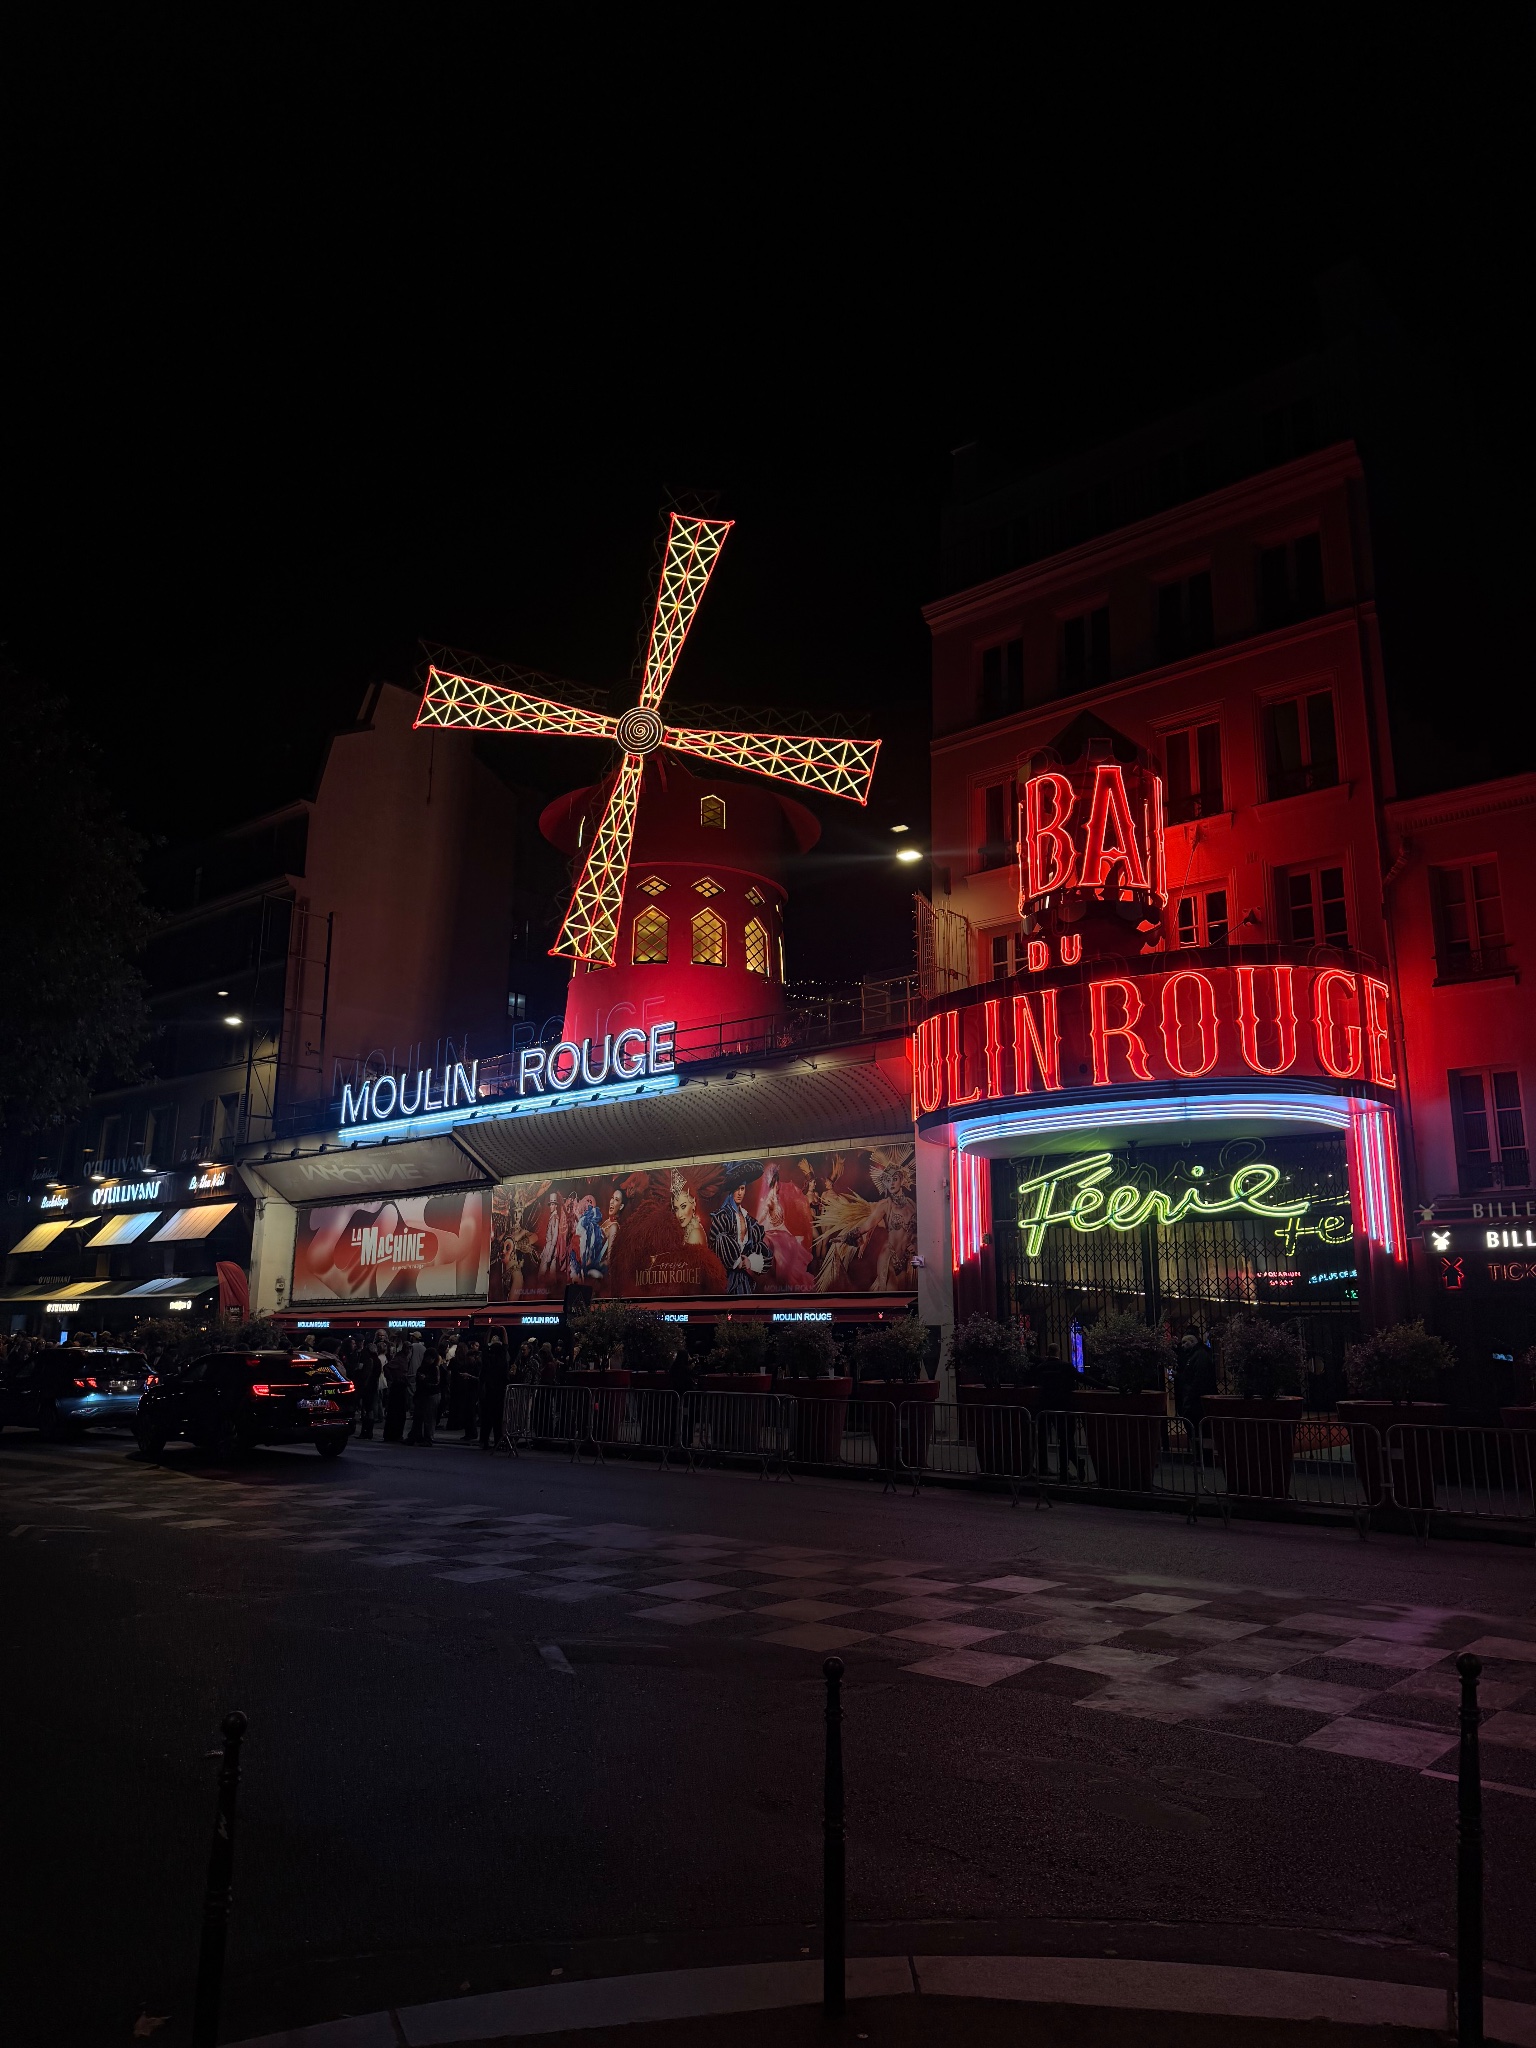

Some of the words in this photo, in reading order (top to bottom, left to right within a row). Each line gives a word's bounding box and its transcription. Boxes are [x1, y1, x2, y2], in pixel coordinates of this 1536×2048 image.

[1027, 934, 1083, 972] DU
[913, 989, 1064, 1121] ULIN
[1089, 965, 1396, 1090] ROUGE
[340, 1058, 479, 1124] MOULIN
[519, 1021, 677, 1096] ROUGE
[1018, 1153, 1311, 1258] Féerie
[351, 1228, 361, 1242] LA
[1486, 1229, 1536, 1248] BILL
[635, 1269, 668, 1287] MOULIN
[669, 1267, 701, 1285] ROUGE
[1487, 1263, 1536, 1281] TICK
[408, 1320, 426, 1328] ROUGE
[522, 1316, 543, 1324] MOULIN
[664, 1314, 689, 1322] ROUGE
[773, 1313, 802, 1321] MOULIN
[804, 1313, 832, 1321] ROUGE
